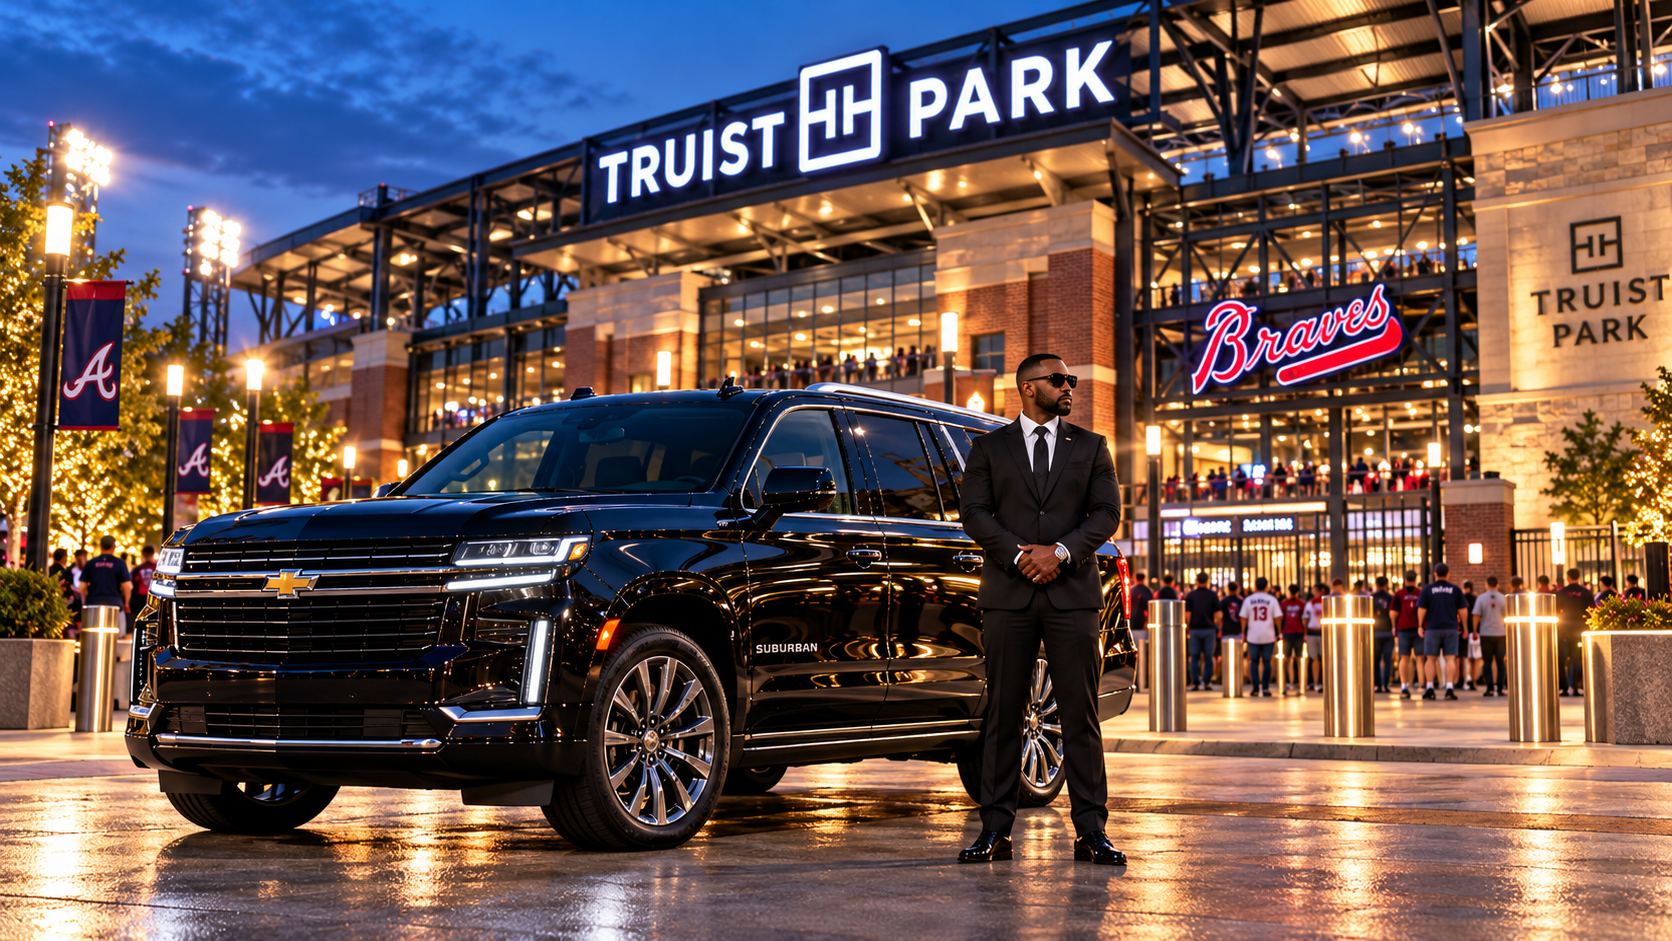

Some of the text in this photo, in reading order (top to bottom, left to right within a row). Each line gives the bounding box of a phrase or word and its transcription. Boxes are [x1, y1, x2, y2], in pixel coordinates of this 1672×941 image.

[599, 40, 1115, 203] TRUIST PARK
[1531, 274, 1670, 316] TRUIST
[1192, 284, 1390, 395] Braves
[1552, 314, 1649, 348] PARK
[62, 341, 117, 401] A
[178, 442, 210, 477] A
[258, 455, 290, 488] A
[1253, 606, 1268, 621] 13
[755, 642, 819, 654] SUBURBAN
